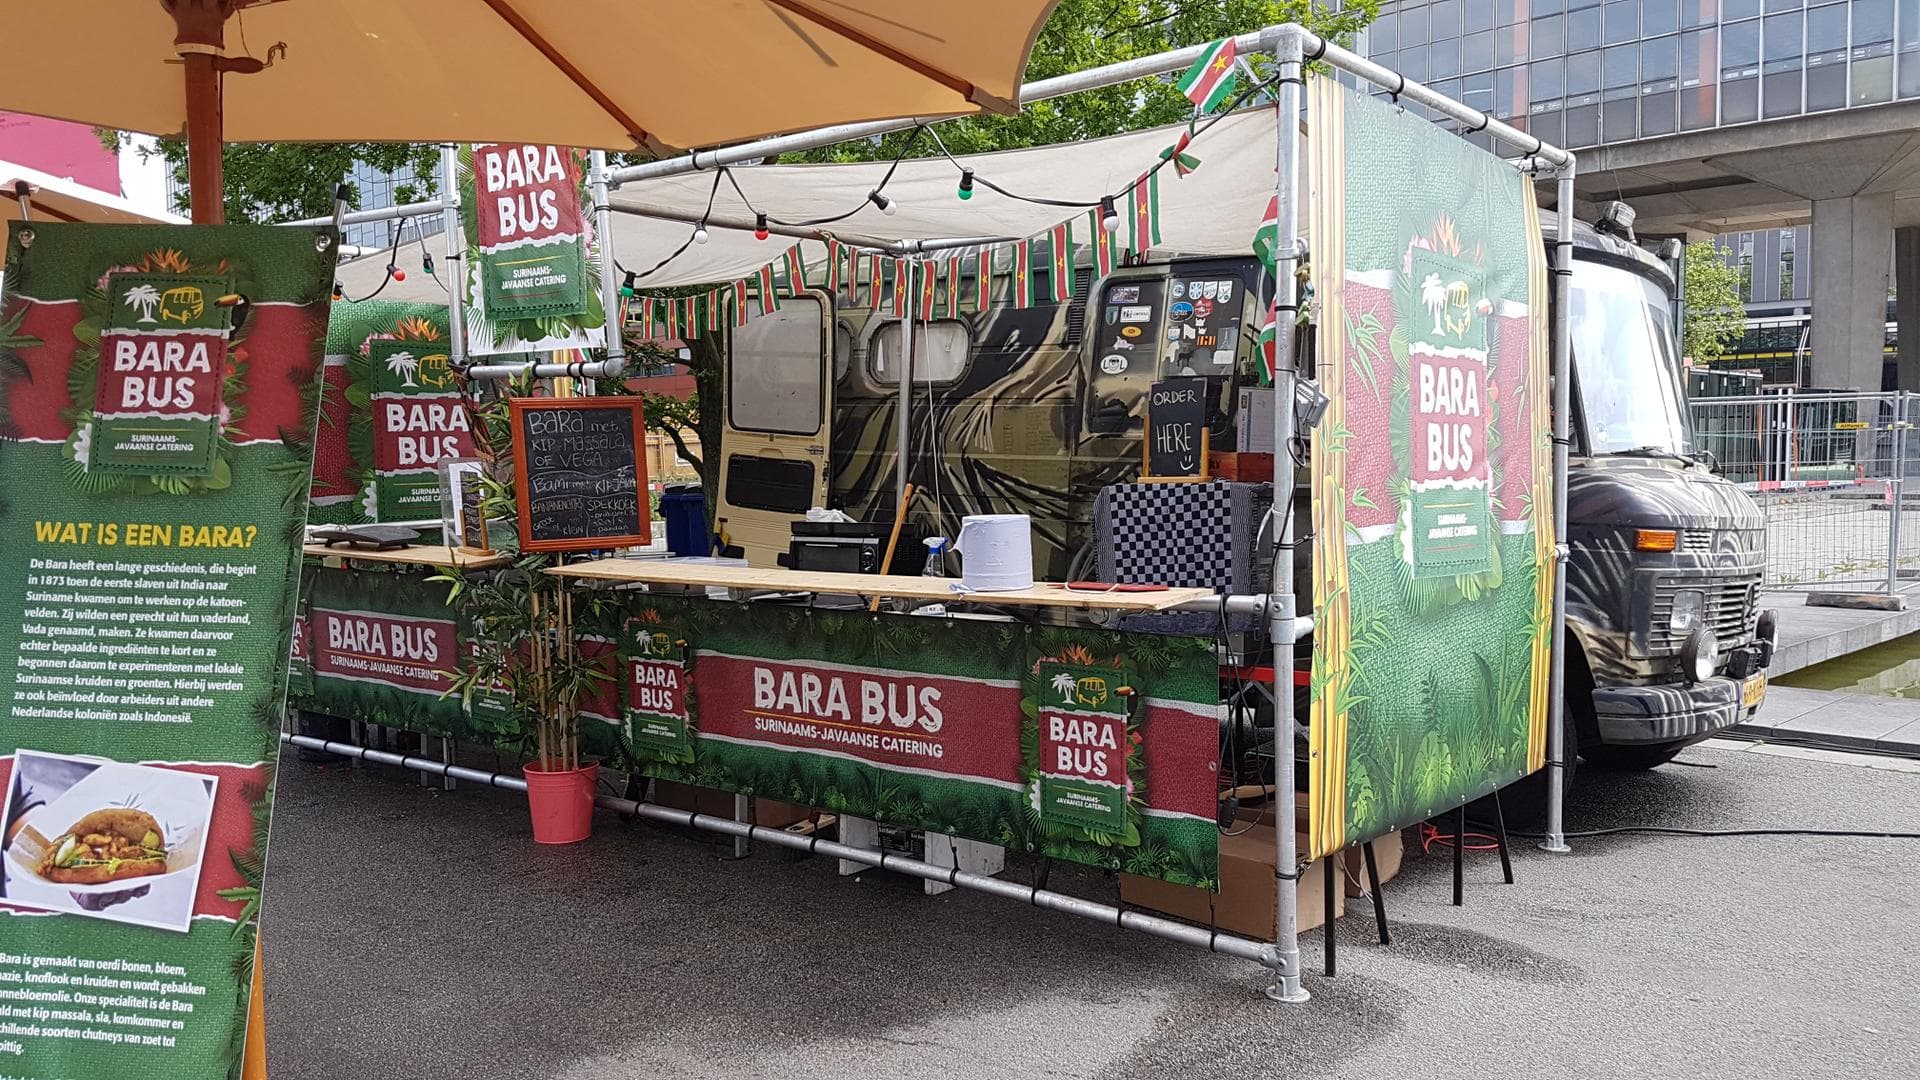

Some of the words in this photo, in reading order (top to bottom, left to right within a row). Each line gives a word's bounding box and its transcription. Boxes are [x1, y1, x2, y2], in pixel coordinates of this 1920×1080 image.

[485, 145, 566, 192] BARA
[498, 189, 559, 237] BUS
[501, 278, 535, 290] JAVAANSE
[534, 274, 566, 287] CATERING
[114, 340, 211, 373] BARA
[121, 376, 195, 409] BUS
[1153, 389, 1197, 406] ORDER
[1419, 362, 1480, 417] BARA
[386, 403, 470, 432] BARA
[114, 442, 155, 451] JAVAANSE
[155, 442, 194, 452] CATERING
[131, 435, 179, 443] SURINAAMS-
[532, 440, 556, 451] KIP
[1156, 422, 1192, 453] HERE
[1427, 423, 1473, 472] BUS
[398, 436, 460, 465] BUS
[535, 456, 552, 467] OF
[560, 452, 602, 468] VEGA
[35, 521, 92, 544] WAT
[97, 523, 118, 545] IS
[125, 524, 172, 546] EEN
[179, 525, 257, 547] BARA?
[30, 559, 44, 569] De
[45, 559, 68, 570] Bara
[69, 560, 94, 571] heeft
[95, 563, 114, 571] een
[115, 561, 142, 574] lange
[143, 561, 207, 576] geschiedenis,
[209, 563, 224, 574] die
[226, 563, 256, 577] begint
[27, 575, 38, 586] in
[40, 575, 65, 586] 1873
[66, 576, 88, 587] toen
[89, 577, 102, 587] de
[103, 577, 133, 588] eerste
[133, 578, 165, 589] slaven
[165, 579, 179, 589] uit
[179, 579, 205, 590] India
[205, 582, 229, 591] naar
[26, 591, 73, 602] Suriname
[74, 592, 116, 604] kwamen
[117, 596, 133, 604] om
[134, 594, 144, 604] te
[145, 594, 181, 605] werken
[182, 598, 195, 608] op
[196, 596, 209, 606] de
[209, 596, 247, 607] katoen-
[24, 607, 59, 619] velden.
[61, 608, 74, 621] Zij
[75, 609, 108, 620] wilden
[109, 612, 128, 620] een
[128, 610, 165, 624] gerecht
[165, 611, 179, 622] uit
[180, 612, 199, 623] hun
[200, 612, 250, 627] vaderland,
[22, 624, 46, 635] Vada
[47, 625, 96, 639] genaamd,
[98, 626, 133, 638] maken.
[135, 627, 147, 638] Ze
[147, 628, 189, 639] kwamen
[190, 629, 234, 640] daarvoor
[328, 616, 387, 656] BARA
[391, 624, 438, 663] BUS
[20, 640, 51, 651] echter
[52, 641, 98, 655] bepaalde
[99, 642, 159, 657] ingrediënten
[160, 644, 170, 655] te
[171, 645, 191, 656] kort
[192, 648, 204, 656] en
[206, 648, 217, 656] ze
[17, 656, 67, 670] begonnen
[68, 658, 106, 669] daarom
[107, 659, 117, 670] te
[118, 659, 193, 675] experimenteren
[194, 662, 213, 673] met
[214, 662, 244, 674] lokale
[330, 654, 404, 676] SURINAAMS-JAVAANSE
[404, 669, 439, 682] CATERING
[635, 664, 678, 689] BARA
[15, 673, 73, 685] Surinaamse
[74, 675, 113, 686] kruiden
[114, 679, 126, 687] en
[128, 677, 172, 691] groenten.
[174, 678, 206, 692] Hierbij
[207, 679, 243, 690] werden
[14, 692, 25, 700] ze
[26, 690, 45, 701] ook
[47, 691, 94, 703] beïnvloed
[95, 693, 119, 704] door
[120, 693, 165, 705] arbeiders
[166, 695, 179, 706] uit
[180, 696, 214, 707] andere
[641, 687, 673, 711] BUS
[754, 666, 851, 721] BARA
[861, 679, 944, 733] BUS
[11, 706, 74, 719] Nederlandse
[74, 708, 117, 720] koloniën
[119, 710, 143, 721] zoals
[144, 711, 193, 723] Indonesië.
[755, 717, 879, 750] SURINAAMS-JAVAANSE
[881, 736, 944, 759] CATERING
[1049, 716, 1118, 750] BARA
[1057, 746, 1108, 777] BUS
[0, 952, 21, 965] Bara
[22, 954, 31, 966] is
[32, 954, 76, 971] gemaakt
[78, 960, 95, 969] van
[96, 958, 120, 971] oerdi
[121, 960, 153, 976] bonen,
[154, 962, 186, 978] bloem,
[0, 970, 23, 986] azie,
[24, 972, 69, 986] knoflook
[70, 977, 82, 987] en
[83, 976, 118, 989] kruiden
[119, 981, 131, 990] en
[133, 980, 160, 991] wordt
[160, 982, 206, 994] gebakken
[73, 993, 97, 1006] Onze
[98, 994, 148, 1012] specialiteit
[149, 998, 157, 1010] is
[158, 998, 171, 1011] de
[171, 999, 193, 1012] Bara
[12, 1005, 31, 1018] met
[32, 1007, 49, 1022] kip
[50, 1008, 93, 1025] massala,
[95, 1012, 111, 1027] sla,
[112, 1013, 171, 1029] komkommer
[171, 1020, 183, 1030] en
[0, 1021, 40, 1036] hillende
[41, 1025, 80, 1039] soorten
[81, 1028, 122, 1045] chutneys
[124, 1034, 140, 1044] van
[142, 1033, 161, 1046] zoet
[162, 1035, 175, 1047] tot
